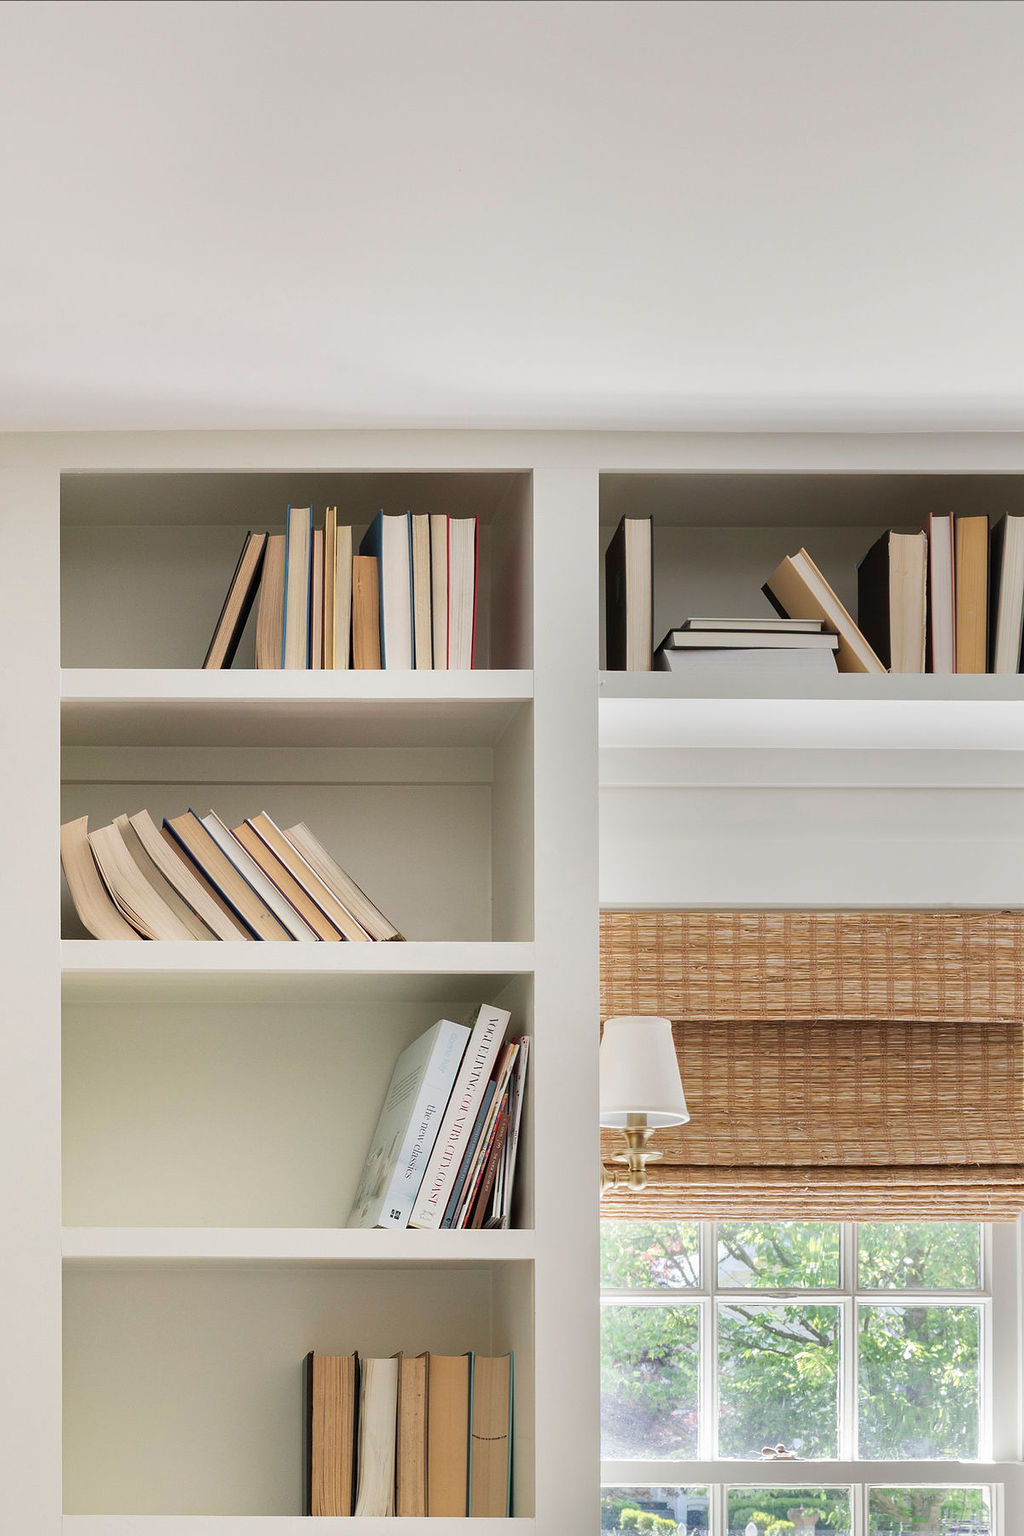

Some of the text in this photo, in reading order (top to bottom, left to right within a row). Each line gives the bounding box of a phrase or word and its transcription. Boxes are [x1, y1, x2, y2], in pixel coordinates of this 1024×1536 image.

[478, 1018, 499, 1053] VOGUE
[466, 1054, 486, 1091] LIVING
[404, 1104, 436, 1179] the new classics
[428, 1171, 446, 1206] COAST
